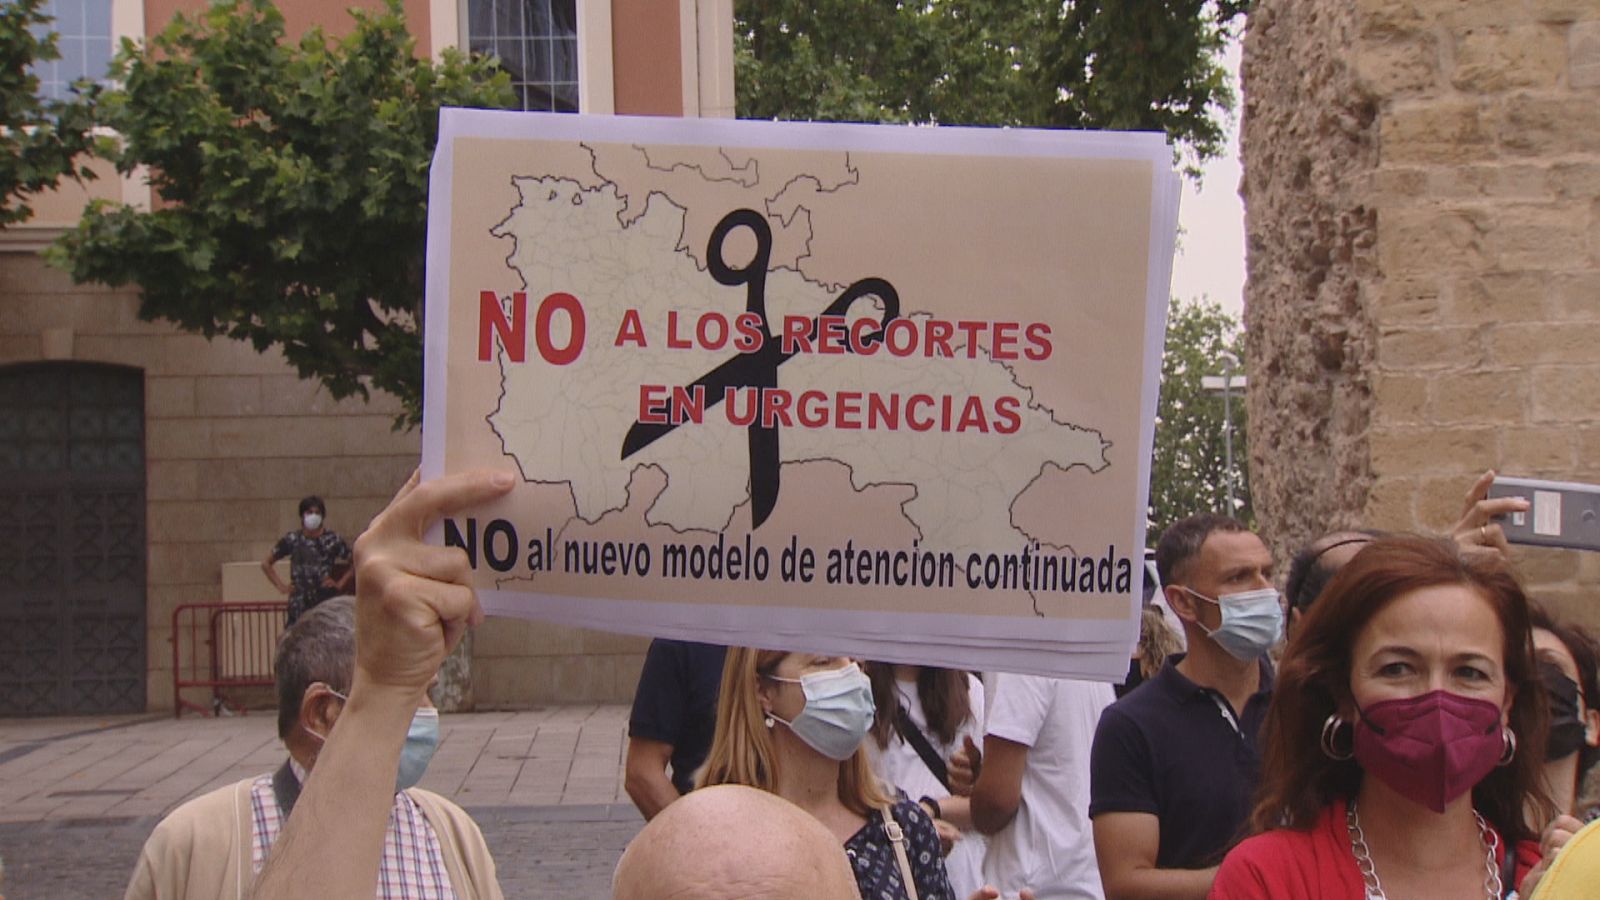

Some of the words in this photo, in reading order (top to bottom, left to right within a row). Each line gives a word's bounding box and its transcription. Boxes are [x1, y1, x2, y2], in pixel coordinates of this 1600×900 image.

[478, 291, 586, 365] NO
[614, 309, 648, 348] A
[667, 311, 763, 353] LOS
[782, 315, 1053, 361] RECORTES
[639, 384, 704, 425] EN
[726, 387, 1022, 434] URGENCIAS
[444, 518, 518, 573] NO
[527, 528, 552, 572] al
[564, 539, 650, 577] nuevo
[662, 533, 769, 581] modelo
[781, 535, 816, 583] de
[827, 539, 955, 588] atencion
[966, 543, 1131, 594] continuada
